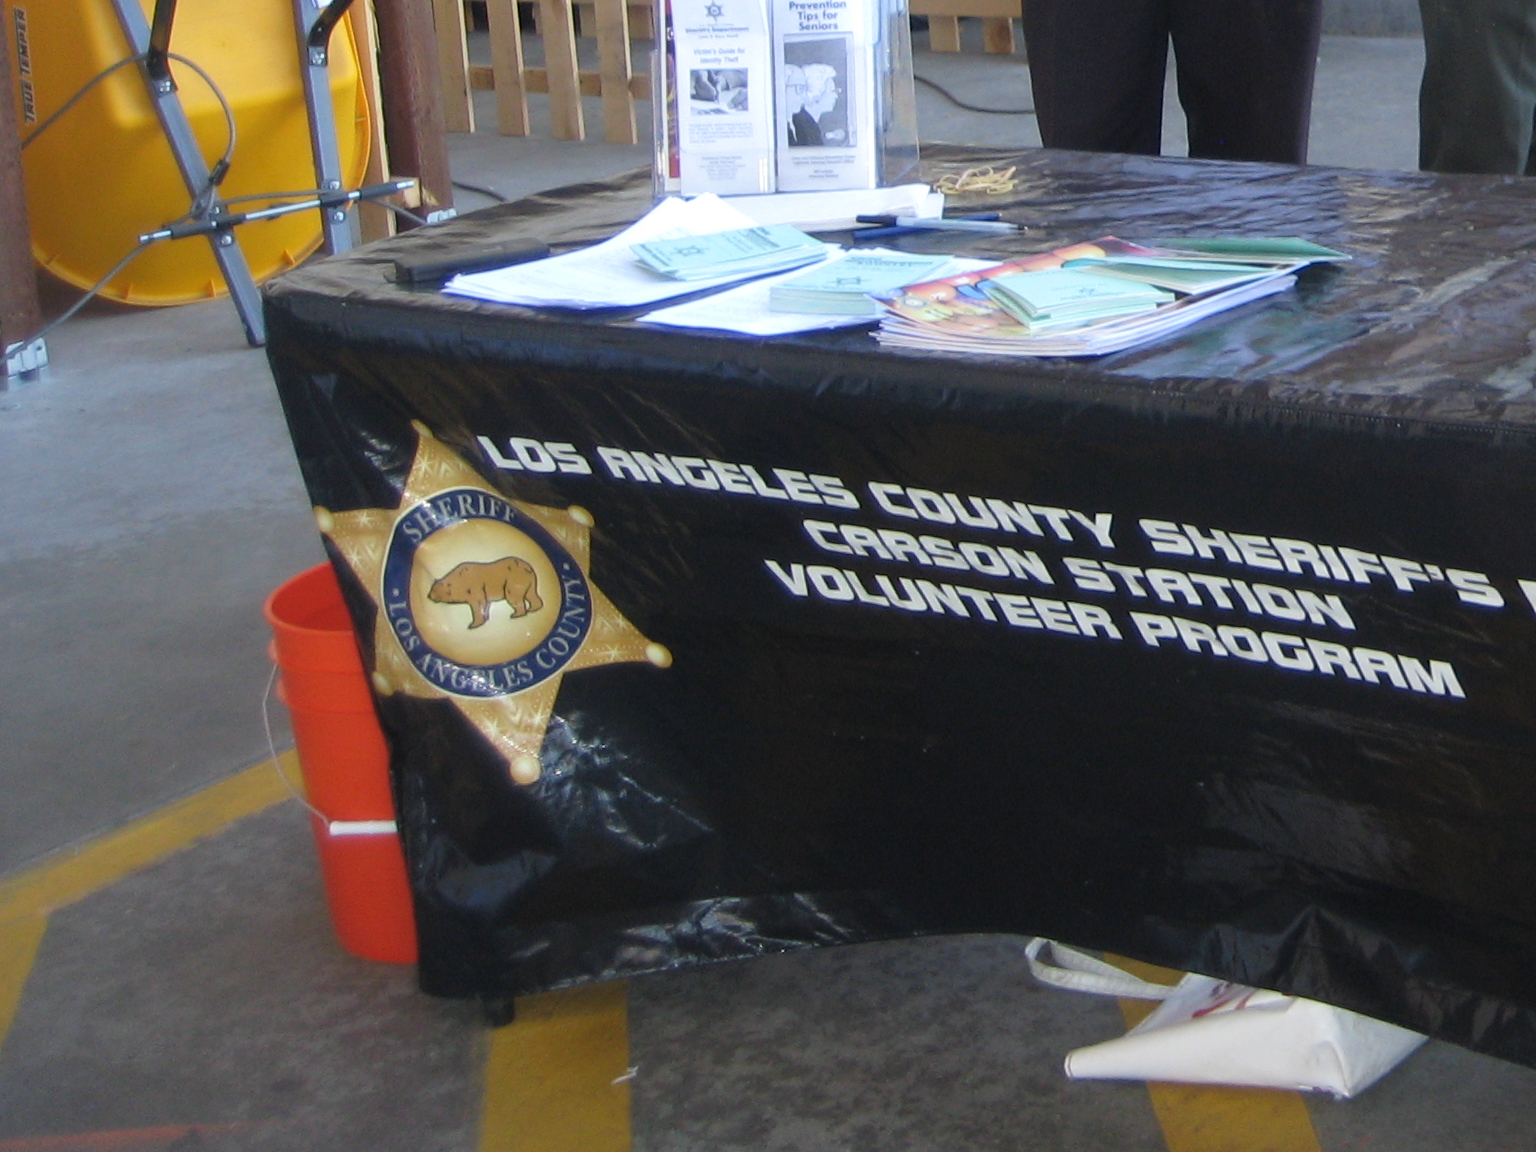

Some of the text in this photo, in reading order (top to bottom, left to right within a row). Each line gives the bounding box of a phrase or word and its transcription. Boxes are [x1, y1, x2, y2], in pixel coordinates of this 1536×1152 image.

[789, 0, 847, 11] Prevention
[797, 11, 838, 22] Tips for
[799, 21, 839, 31] Seniors
[13, 6, 37, 125] TRUE TEMPER
[401, 496, 518, 544] SHERIFF
[477, 434, 593, 476] LOS
[597, 445, 861, 512] ANGELES
[868, 480, 1114, 549] COUNTY
[1137, 518, 1506, 608] SHERIFF'S
[803, 519, 1357, 631] CARSON STATION
[388, 573, 588, 692] LOS ANGELES COUNTY
[764, 558, 1467, 699] VOLUNTEER PROGRAM
